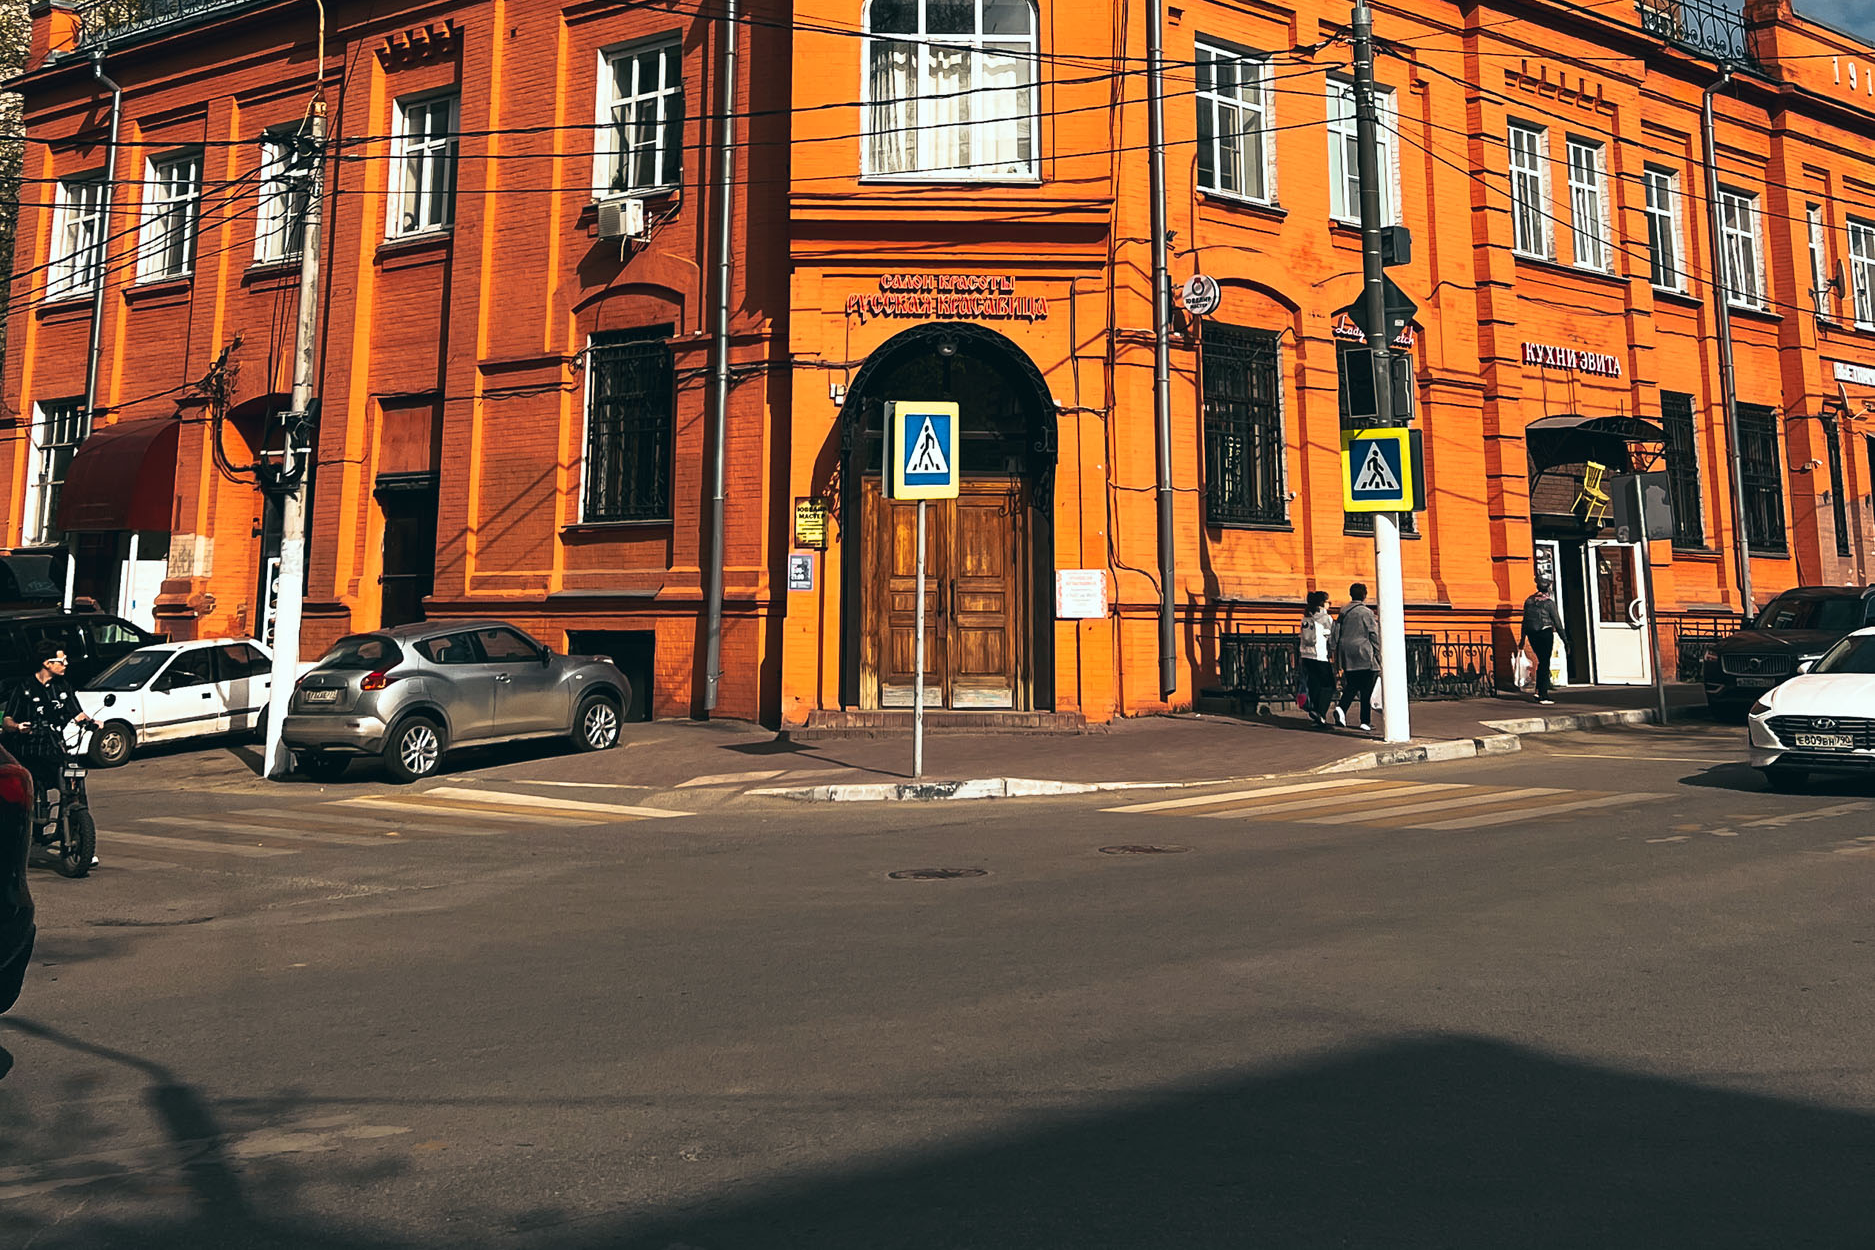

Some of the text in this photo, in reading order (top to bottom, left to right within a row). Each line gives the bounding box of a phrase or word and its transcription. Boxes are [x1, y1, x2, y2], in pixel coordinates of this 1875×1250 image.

[880, 273, 1016, 292] САЛОН КРАСОТЫ
[847, 293, 1049, 321] РУССКАЯ КРАСАВИЦА
[1335, 314, 1415, 345] Lady etch
[1524, 341, 1622, 375] КУХНИ ЭВИТА
